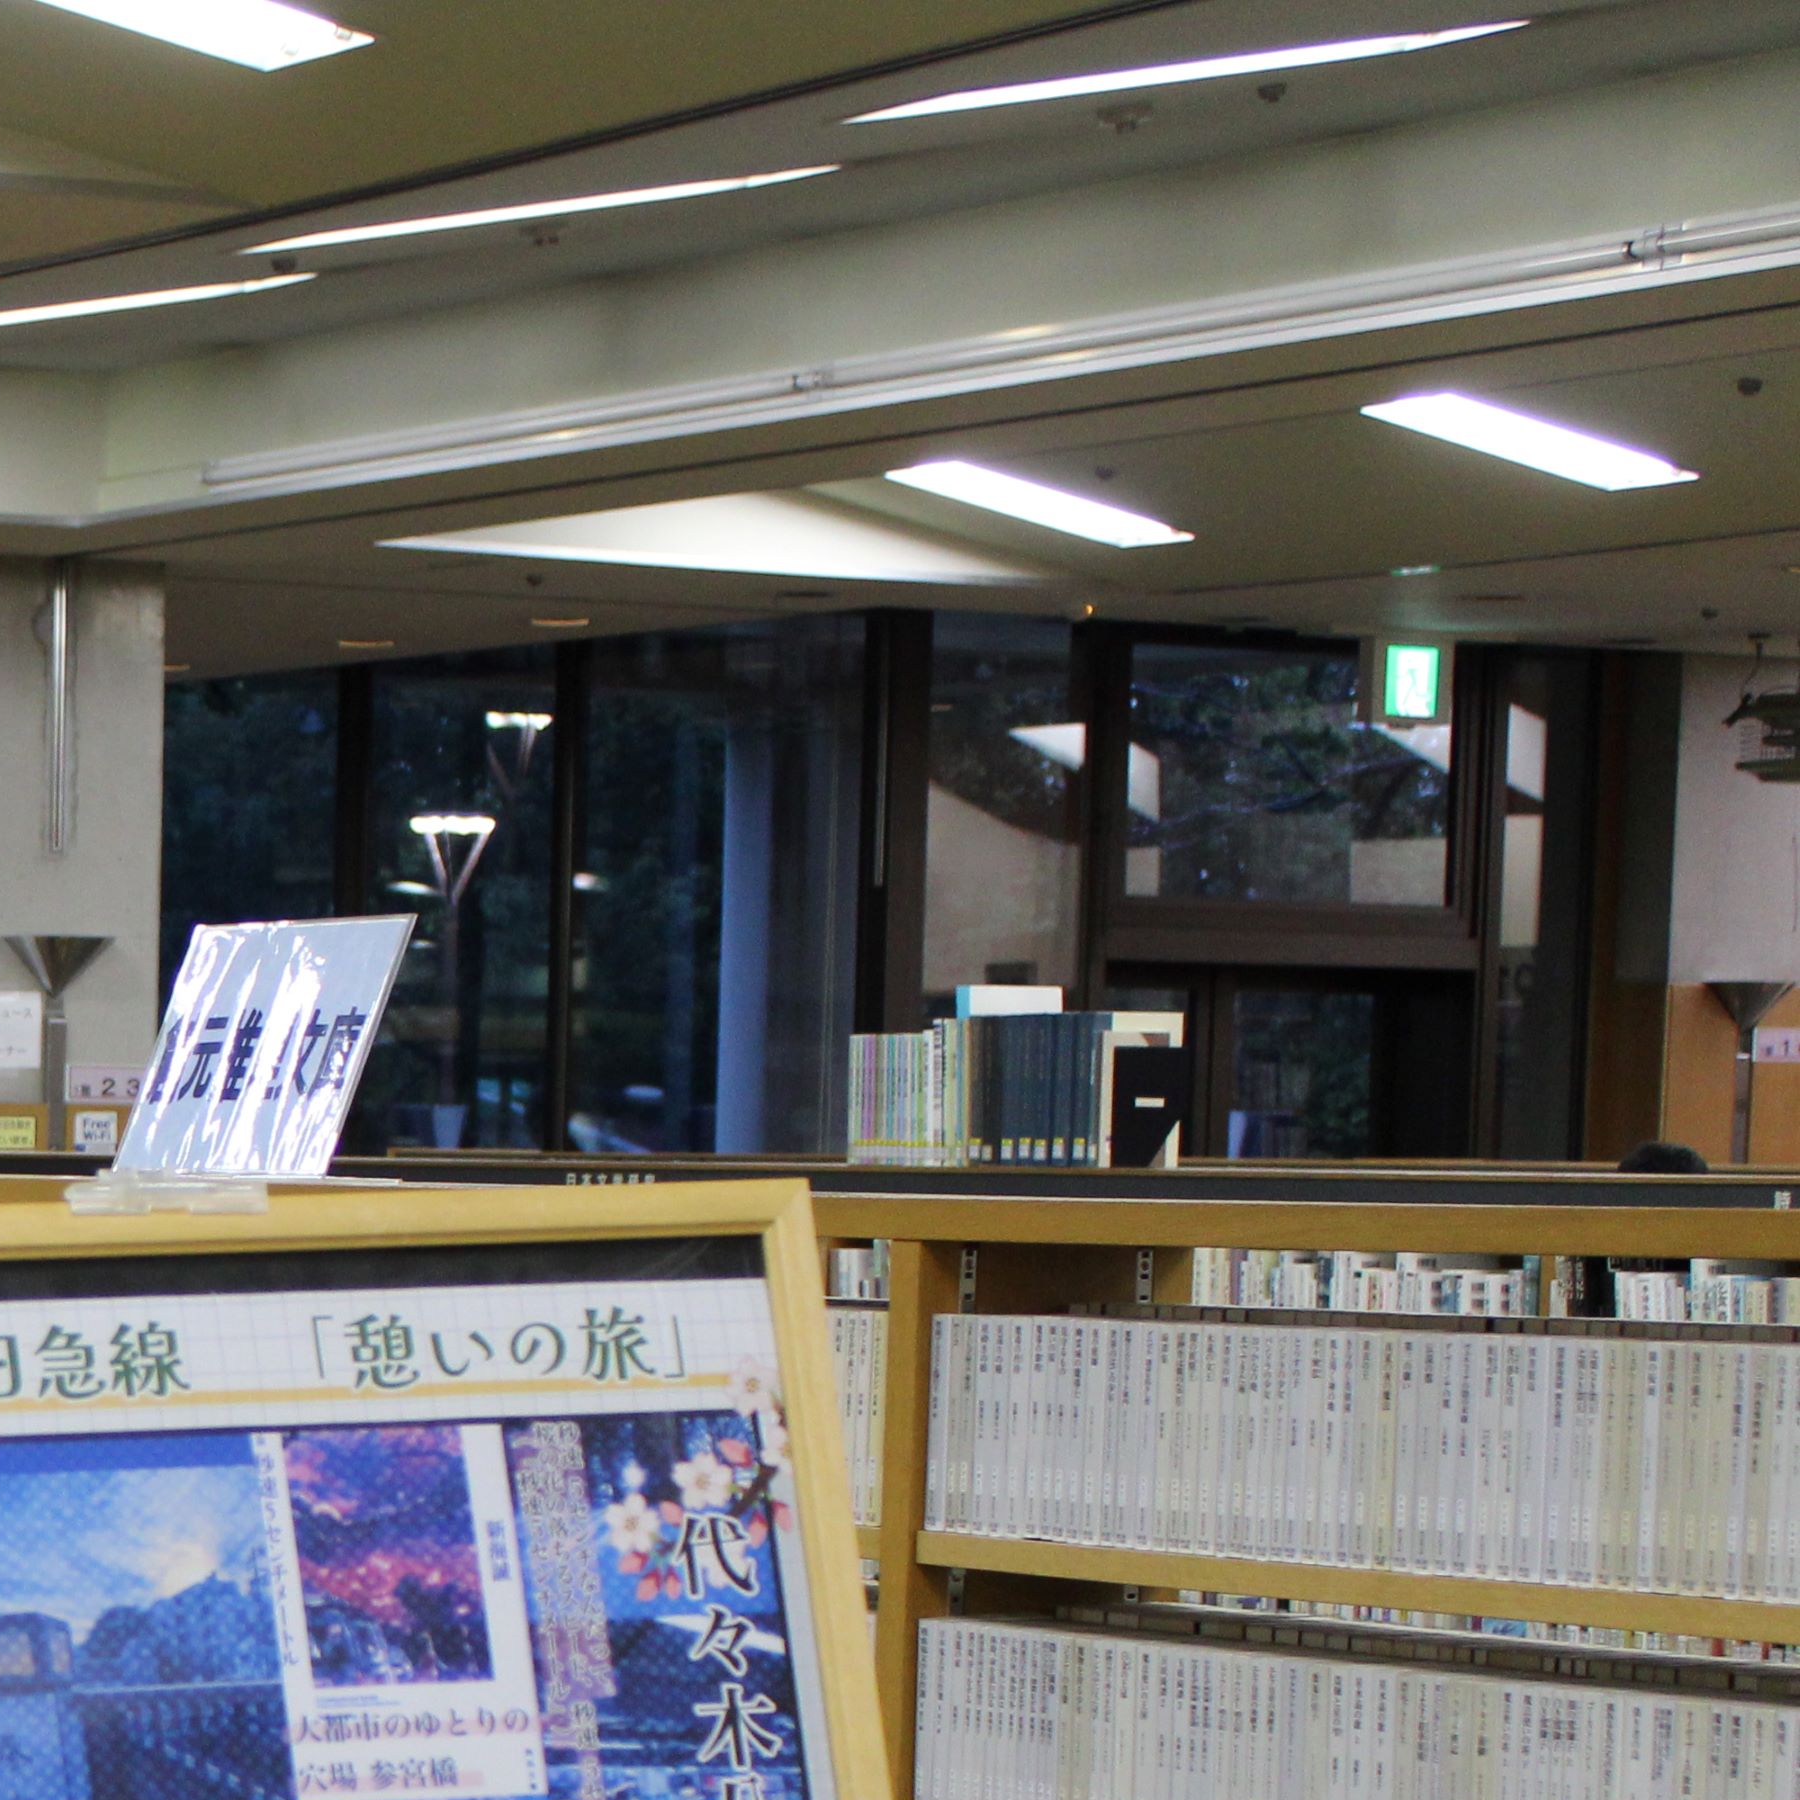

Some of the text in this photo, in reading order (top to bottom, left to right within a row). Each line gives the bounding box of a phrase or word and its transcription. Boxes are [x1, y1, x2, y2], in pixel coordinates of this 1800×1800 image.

[310, 1305, 689, 1392] 「憩いの旅」
[296, 1706, 531, 1745] 大都市のゆとりの
[298, 1756, 460, 1794] 穴場 参宮橋
